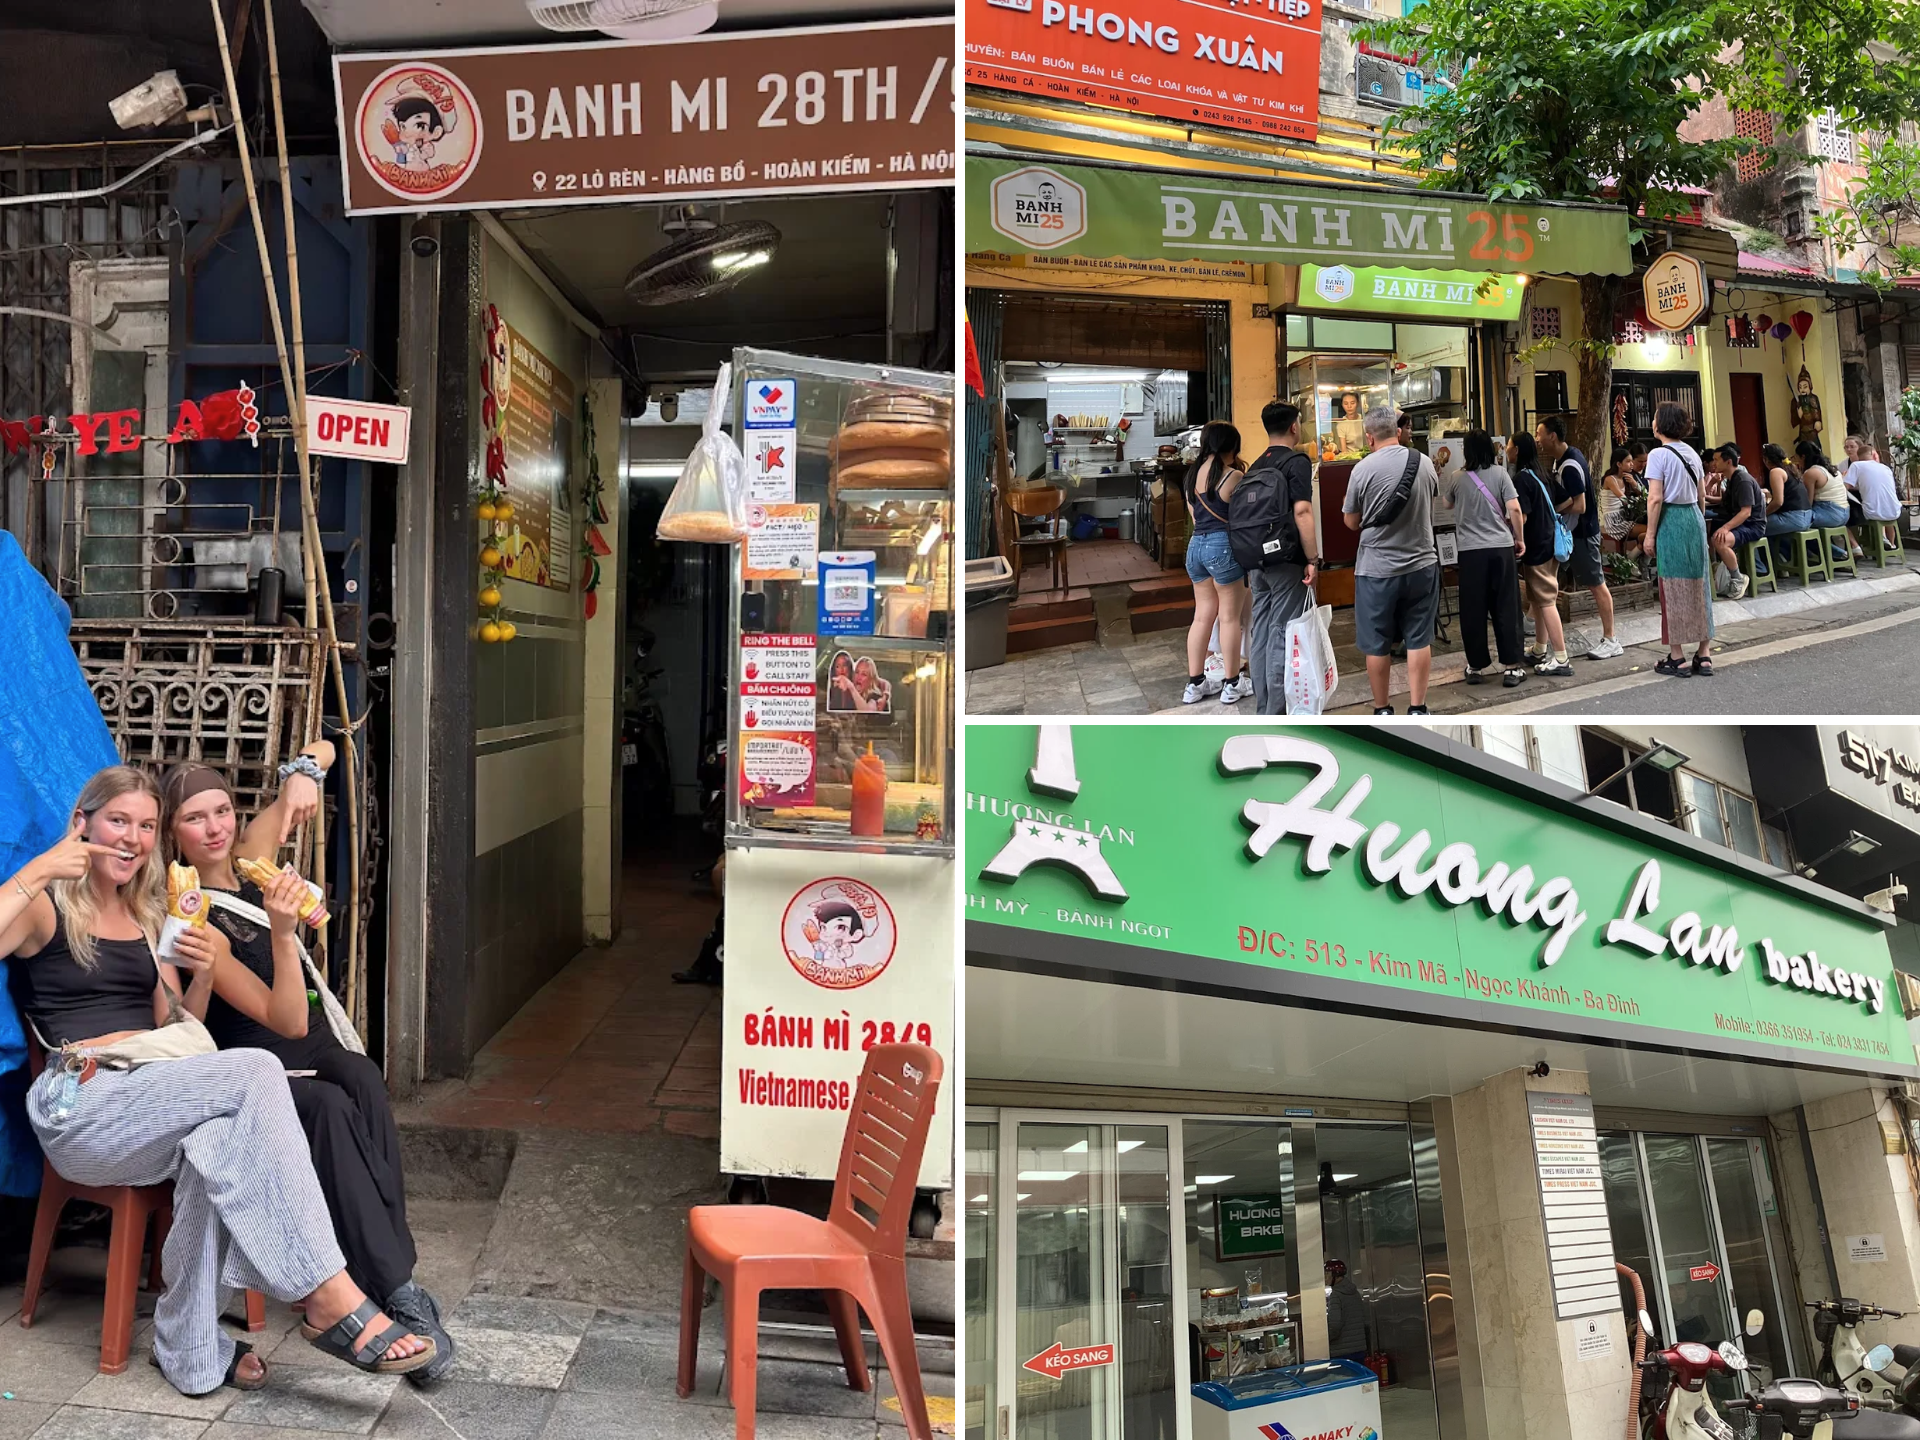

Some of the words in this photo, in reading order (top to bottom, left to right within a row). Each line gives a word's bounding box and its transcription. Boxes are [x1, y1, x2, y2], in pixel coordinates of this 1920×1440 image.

[1042, 0, 1180, 54] PHONG
[1194, 33, 1284, 75] XUÂN
[977, 68, 988, 79] 25
[994, 73, 1017, 84] HÀNG
[1023, 76, 1034, 87] CÁ
[1047, 82, 1070, 93] HOÀN
[1076, 86, 1097, 98] KIẾM
[1109, 92, 1121, 103] HÀ
[1127, 95, 1140, 106] NỘI
[1010, 50, 1036, 64] BÁN
[1042, 56, 1075, 71] BUÔN
[1081, 64, 1105, 77] BÁN
[1110, 68, 1125, 81] LẺ
[1130, 73, 1152, 86] CÁC
[1185, 85, 1213, 98] KHÓA
[1216, 89, 1228, 100] VÀ
[1232, 92, 1248, 105] VẬT
[1252, 95, 1265, 107] TƯ
[1269, 99, 1285, 111] KIM
[1289, 103, 1304, 114] KHÍ
[505, 82, 642, 142] BANH
[670, 76, 729, 133] MI
[757, 65, 899, 129] 28TH
[1203, 110, 1220, 120] 0243
[1223, 113, 1235, 122] 928
[1237, 116, 1252, 125] 2145
[1279, 123, 1291, 132] 242
[555, 174, 577, 190] 22
[582, 169, 604, 189] LÒ
[609, 167, 646, 188] RÈN
[664, 164, 715, 186] HÀNG
[764, 158, 816, 180] HOÀN
[821, 153, 870, 177] KIẾM
[889, 151, 916, 173] HÀ
[1015, 199, 1063, 213] BANH
[1160, 195, 1353, 247] BANH
[1381, 212, 1455, 252] MI
[1465, 210, 1535, 263] 25
[1325, 278, 1345, 286] BANH
[1372, 278, 1436, 299] BANH
[1445, 286, 1474, 301] MI
[1657, 282, 1687, 299] BANH
[1255, 306, 1269, 316] 25
[316, 411, 391, 448] OPEN
[744, 636, 769, 646] RING
[771, 636, 791, 646] THE
[792, 636, 815, 646] BELL
[765, 661, 798, 669] BUTTON
[800, 661, 811, 669] TO
[765, 672, 785, 680] CALL
[786, 672, 810, 680] STAFF
[1840, 729, 1891, 786] 517
[1218, 734, 1588, 968] Huong
[1602, 857, 1745, 975] Lan
[1758, 937, 1885, 1015] bakery
[1121, 919, 1174, 940] NGỌT
[804, 962, 845, 984] BÁNH
[1237, 925, 1296, 961] Đ/C:
[1304, 939, 1347, 968] 513
[1368, 949, 1412, 979] Kim
[1417, 959, 1448, 986] Mã
[1465, 967, 1513, 999] Ngọc
[1516, 977, 1572, 1006] Khánh
[1584, 989, 1605, 1012] Ba
[744, 1006, 813, 1049] BÁNH
[823, 1010, 850, 1051] MÌ
[861, 1021, 932, 1052] 28/9
[1714, 1012, 1755, 1035] Mobile:
[1755, 1019, 1780, 1038] 0366
[1781, 1024, 1814, 1044] 351954
[1819, 1030, 1836, 1048] Tel:
[1836, 1034, 1852, 1050] 024
[1872, 1040, 1890, 1056] 7454
[738, 1067, 849, 1111] Vietnamese
[1045, 1353, 1071, 1368] KÉO
[1073, 1350, 1109, 1364] SANG
